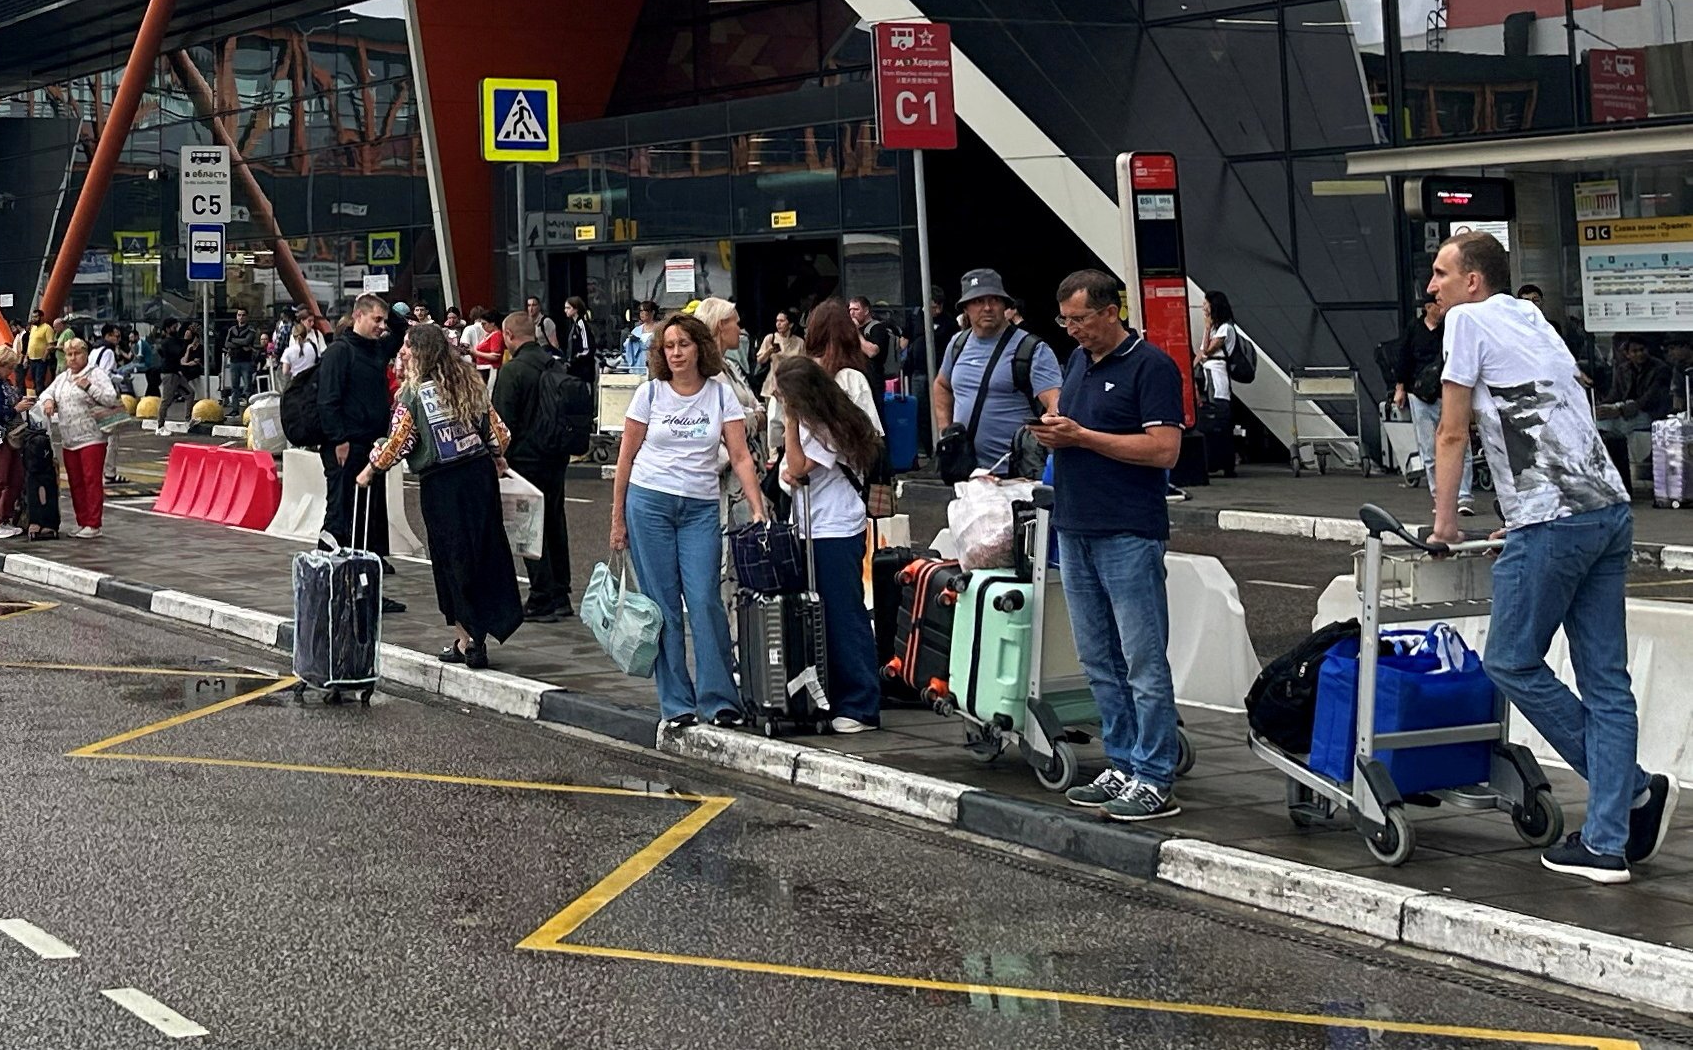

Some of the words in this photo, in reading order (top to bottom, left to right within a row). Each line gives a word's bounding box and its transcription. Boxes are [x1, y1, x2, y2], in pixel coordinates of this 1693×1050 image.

[896, 91, 937, 125] C1
[192, 170, 227, 179] область
[192, 194, 222, 215] C5
[1587, 228, 1594, 238] B
[1601, 228, 1608, 238] C
